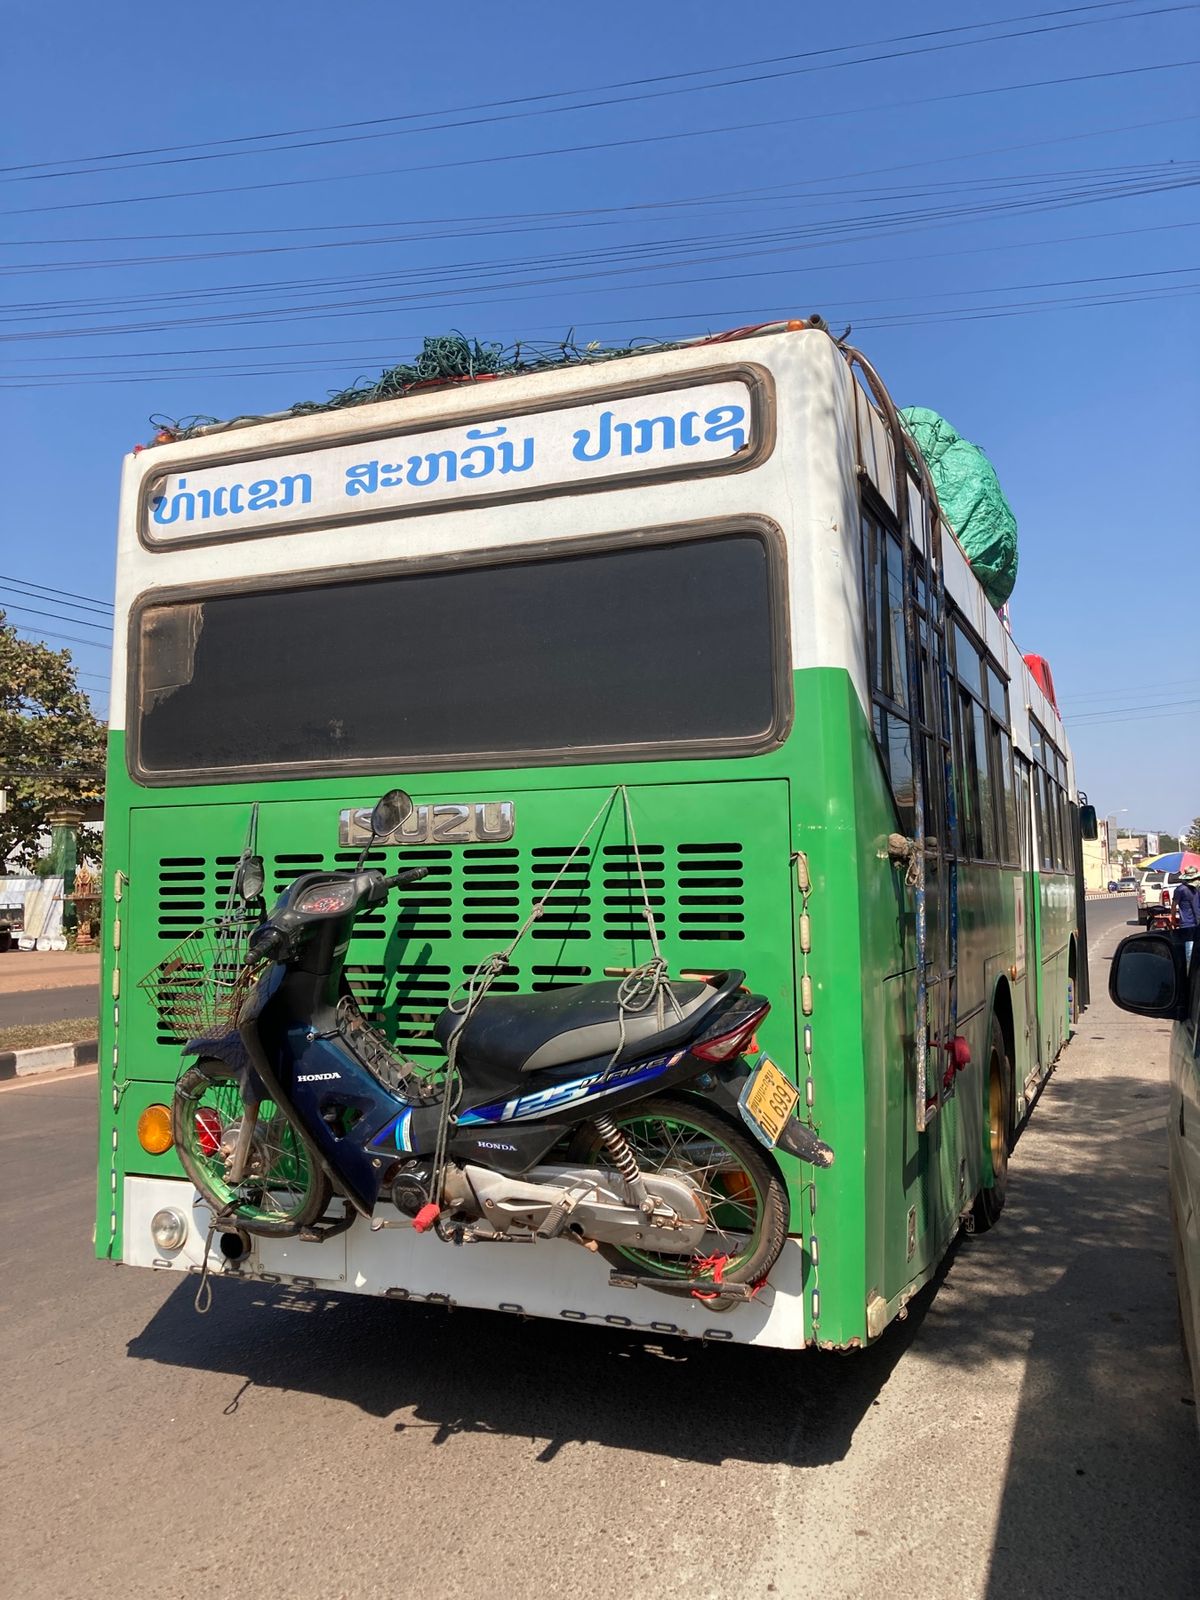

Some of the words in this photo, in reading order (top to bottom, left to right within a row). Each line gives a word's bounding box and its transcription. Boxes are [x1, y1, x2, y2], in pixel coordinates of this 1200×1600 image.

[152, 473, 313, 525] ທ່າແຂກ
[345, 426, 535, 497] ສະຫວັນ
[572, 405, 745, 462] ປາກເຊ
[297, 1072, 342, 1082] HONDA
[500, 1072, 604, 1122] 125
[478, 1140, 517, 1151] HONDA
